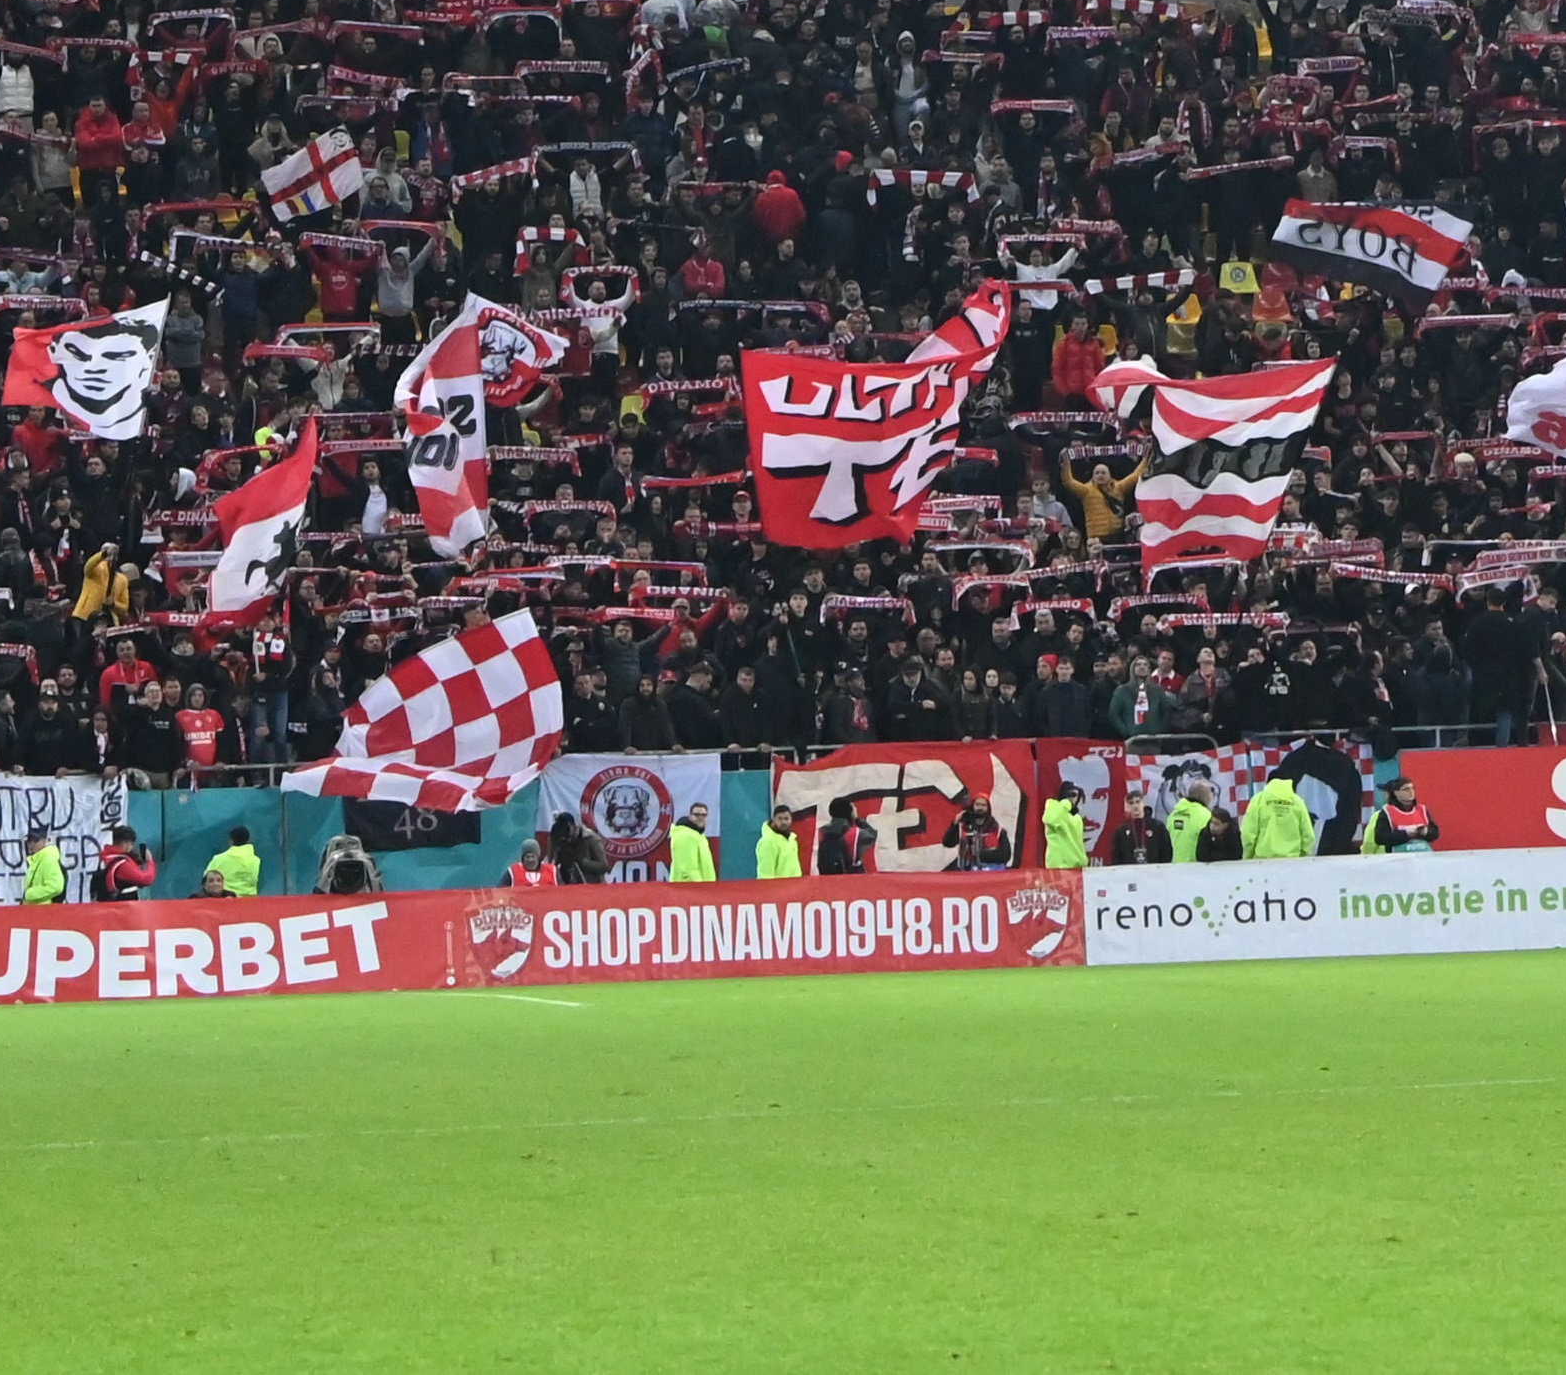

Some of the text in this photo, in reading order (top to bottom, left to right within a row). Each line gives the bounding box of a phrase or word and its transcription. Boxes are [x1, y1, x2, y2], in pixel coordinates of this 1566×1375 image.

[647, 378, 722, 395] DINAMO
[178, 509, 219, 522] DINAM
[184, 729, 217, 741] UNIBET
[1008, 891, 1067, 909] DINAMO
[1339, 885, 1484, 926] inovație
[1494, 877, 1528, 913] în
[543, 895, 998, 969] SHOP.DINAMO1948.RO
